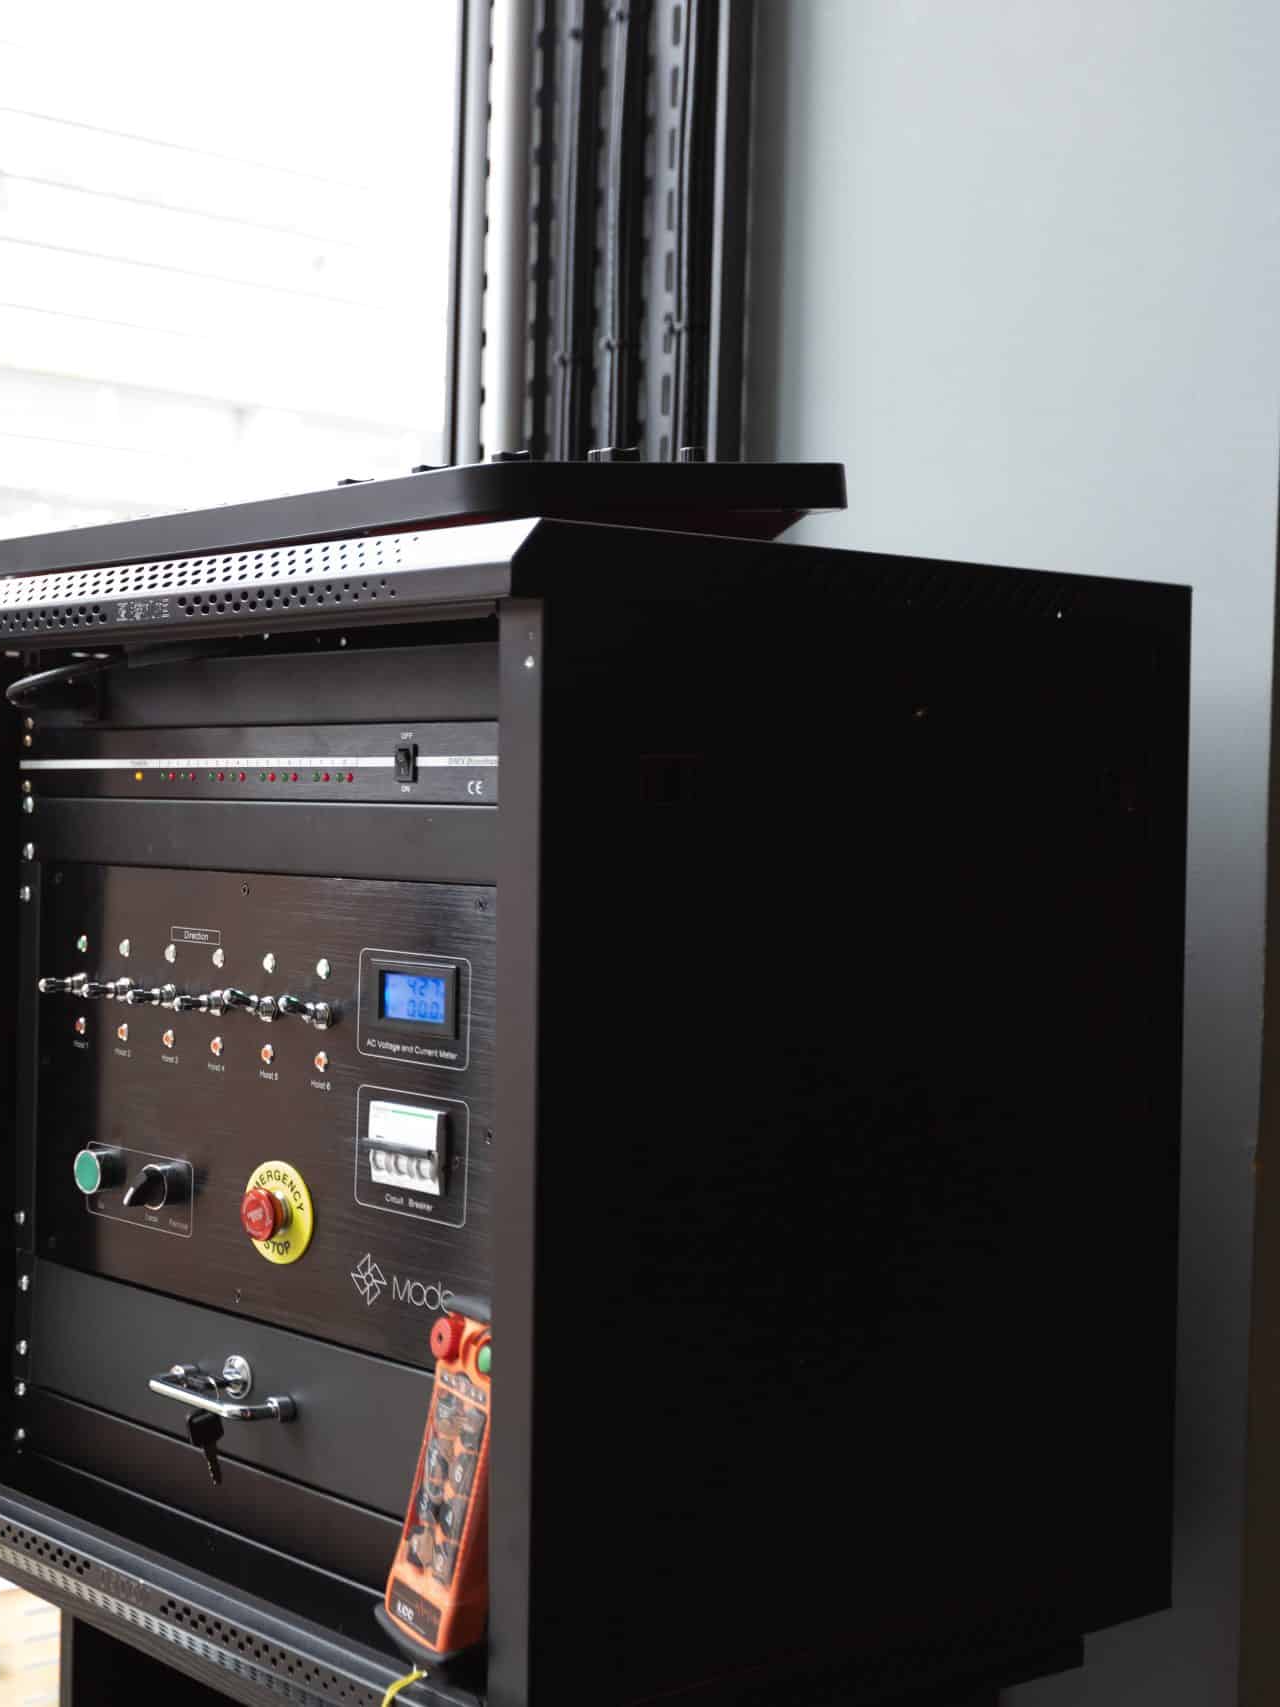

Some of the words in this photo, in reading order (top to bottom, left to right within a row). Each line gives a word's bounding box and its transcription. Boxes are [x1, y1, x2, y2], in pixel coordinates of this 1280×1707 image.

[467, 780, 483, 795] CE
[184, 930, 209, 941] Direction
[367, 1038, 377, 1048] AC
[377, 1040, 401, 1053] Voltage
[414, 1046, 439, 1057] Current
[253, 1169, 305, 1212] MERGENCY
[263, 1239, 291, 1256] STOP
[454, 1464, 464, 1483] 6
